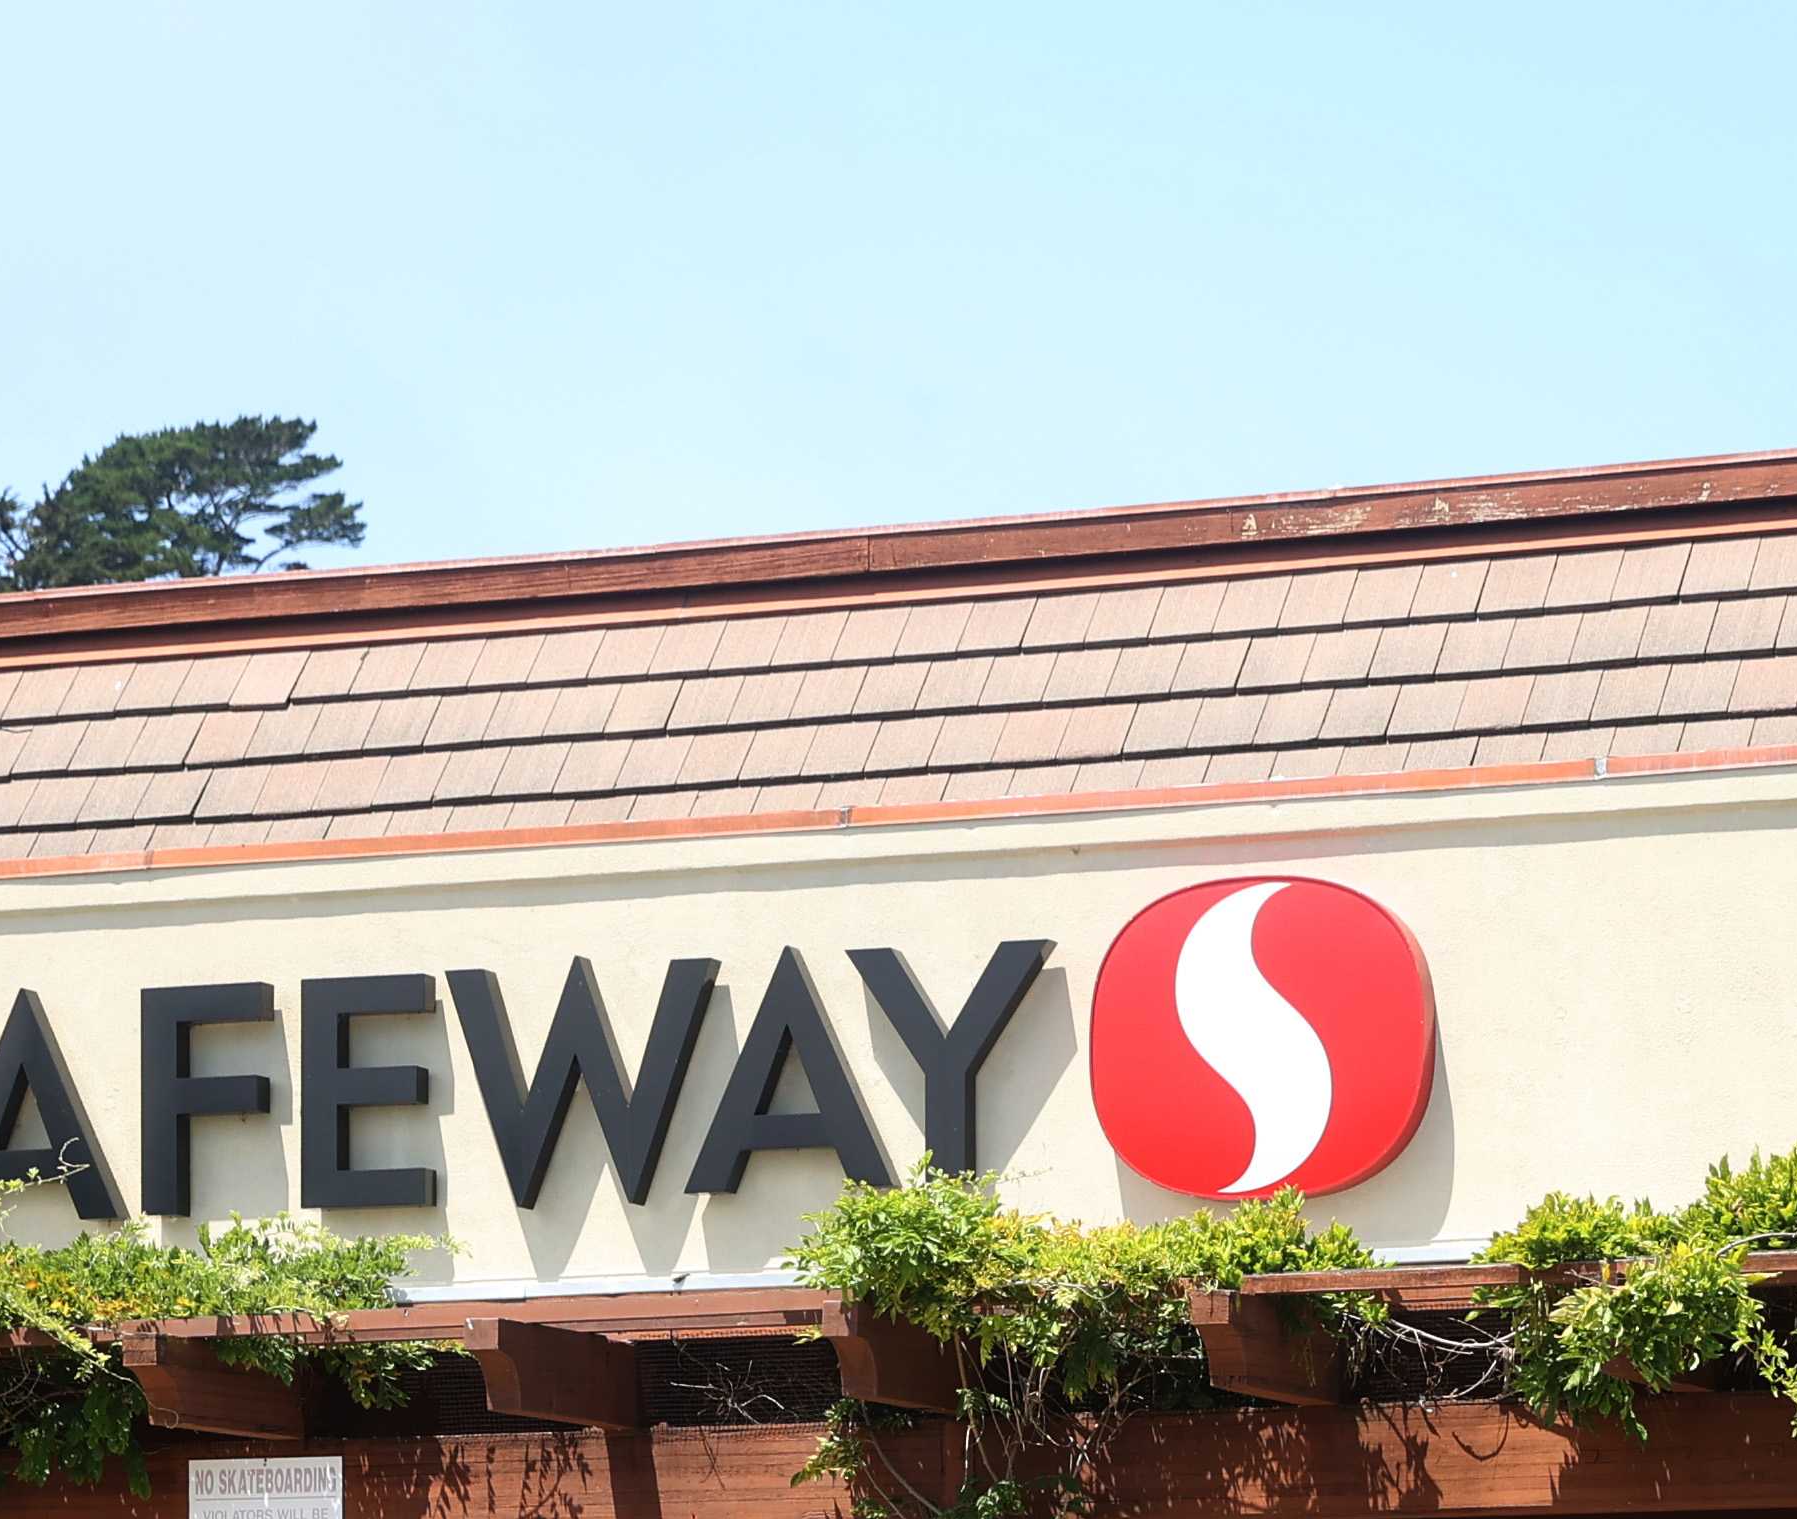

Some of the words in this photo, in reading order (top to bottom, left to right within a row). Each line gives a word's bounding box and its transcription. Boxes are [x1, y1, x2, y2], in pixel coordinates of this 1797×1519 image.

[195, 1470, 214, 1495] NO
[218, 1466, 337, 1495] SKATEBOARDING
[312, 1507, 329, 1519] BE
